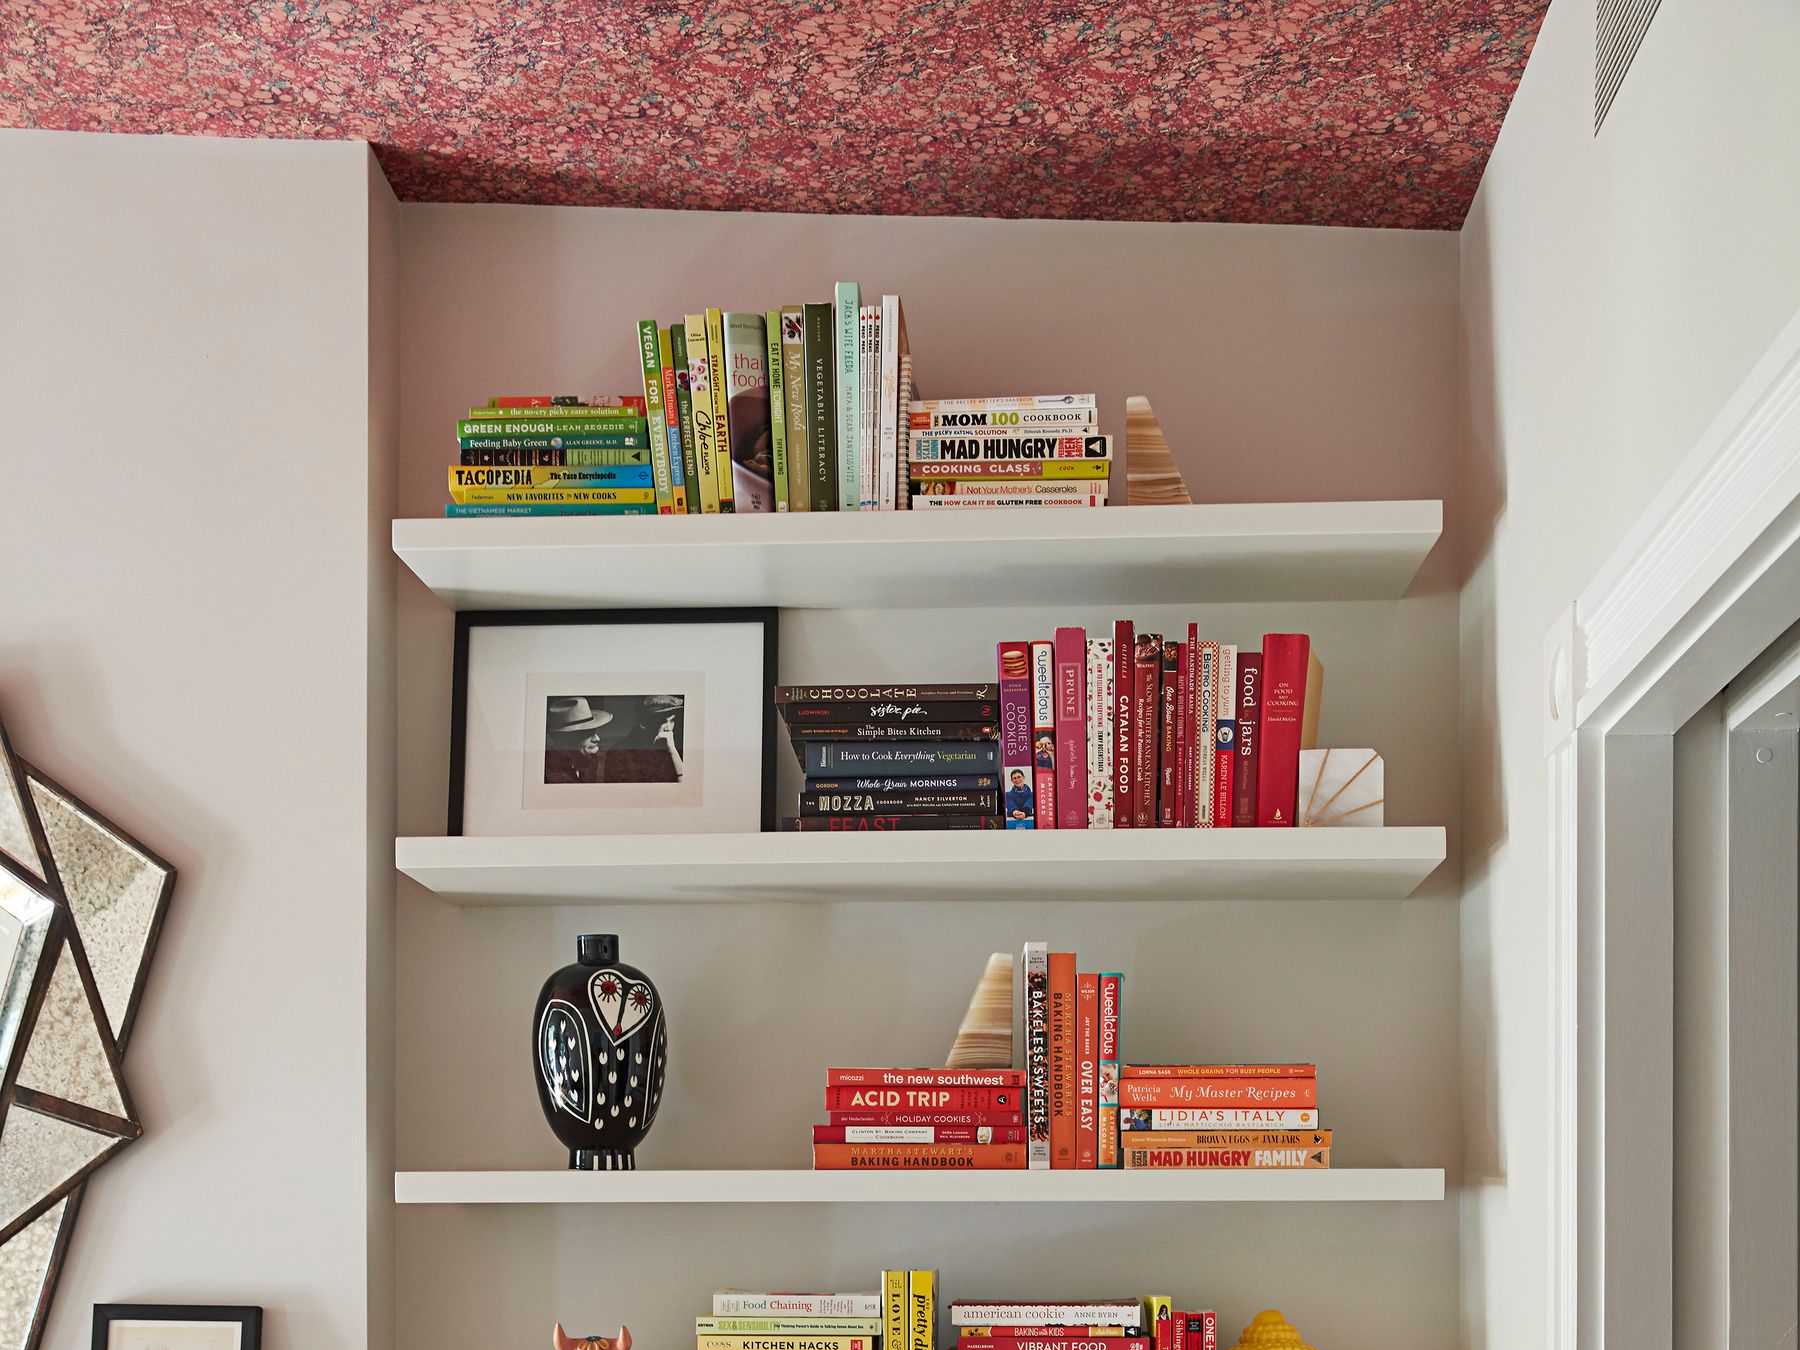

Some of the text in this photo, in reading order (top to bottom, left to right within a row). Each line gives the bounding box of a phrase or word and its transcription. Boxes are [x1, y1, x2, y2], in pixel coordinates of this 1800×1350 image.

[734, 353, 763, 370] thai
[732, 371, 766, 388] food
[643, 326, 668, 493] VEGAN FOR EVERYBODY
[712, 355, 727, 452] STRAIGHT EARTH
[816, 358, 826, 482] VEGETABLE LITERACY
[942, 412, 1081, 426] MOM 100 COOKBOOK
[464, 424, 553, 433] GREEN ENOUGH
[470, 439, 500, 449] Feeding
[502, 439, 521, 448] Baby
[940, 438, 1057, 459] MAD HUNGRY
[1065, 437, 1076, 458] MEN
[578, 472, 616, 480] Encyclopedia
[922, 464, 1030, 474] COOKING CLASS
[456, 469, 532, 485] TACOPEDIA
[574, 492, 589, 500] NEW
[592, 492, 617, 500] COOKS
[1038, 650, 1052, 720] weelicious
[1066, 670, 1075, 714] PRUNE
[810, 688, 917, 699] CHOCOLATE
[1202, 653, 1211, 733] BISTRO COOKING
[1239, 667, 1257, 756] food jars
[857, 728, 884, 738] Simple
[1006, 703, 1027, 756] DORIE'S COOKIES
[1120, 695, 1128, 793] CATALAN FOOD
[841, 752, 860, 760] How
[872, 752, 893, 760] Cook
[895, 752, 935, 763] Everything
[937, 751, 976, 762] Vegetarian
[818, 796, 874, 811] MOZZA
[1032, 991, 1044, 1123] BAKELESS SWEETS
[1054, 993, 1063, 1116] BAKING HANDBOOK
[883, 1073, 1004, 1085] the new southwest
[1081, 1061, 1093, 1131] OVER EASY
[1127, 1085, 1161, 1093] Patricia
[1170, 1086, 1296, 1100] My Master Recipes
[851, 1091, 900, 1107] ACID
[907, 1091, 950, 1107] TRIP
[1132, 1094, 1157, 1102] Wells
[1159, 1111, 1286, 1121] LIDIA'S ITALY
[851, 1157, 974, 1166] BAKING HANDBOOK
[1150, 1151, 1307, 1166] MAD HUNGRY FAMILY
[743, 1301, 767, 1310] Food
[770, 1301, 812, 1312] Chaining
[963, 1310, 1022, 1319] american
[1025, 1308, 1065, 1319] cookie
[743, 1341, 839, 1350] KITCHEN HACKS
